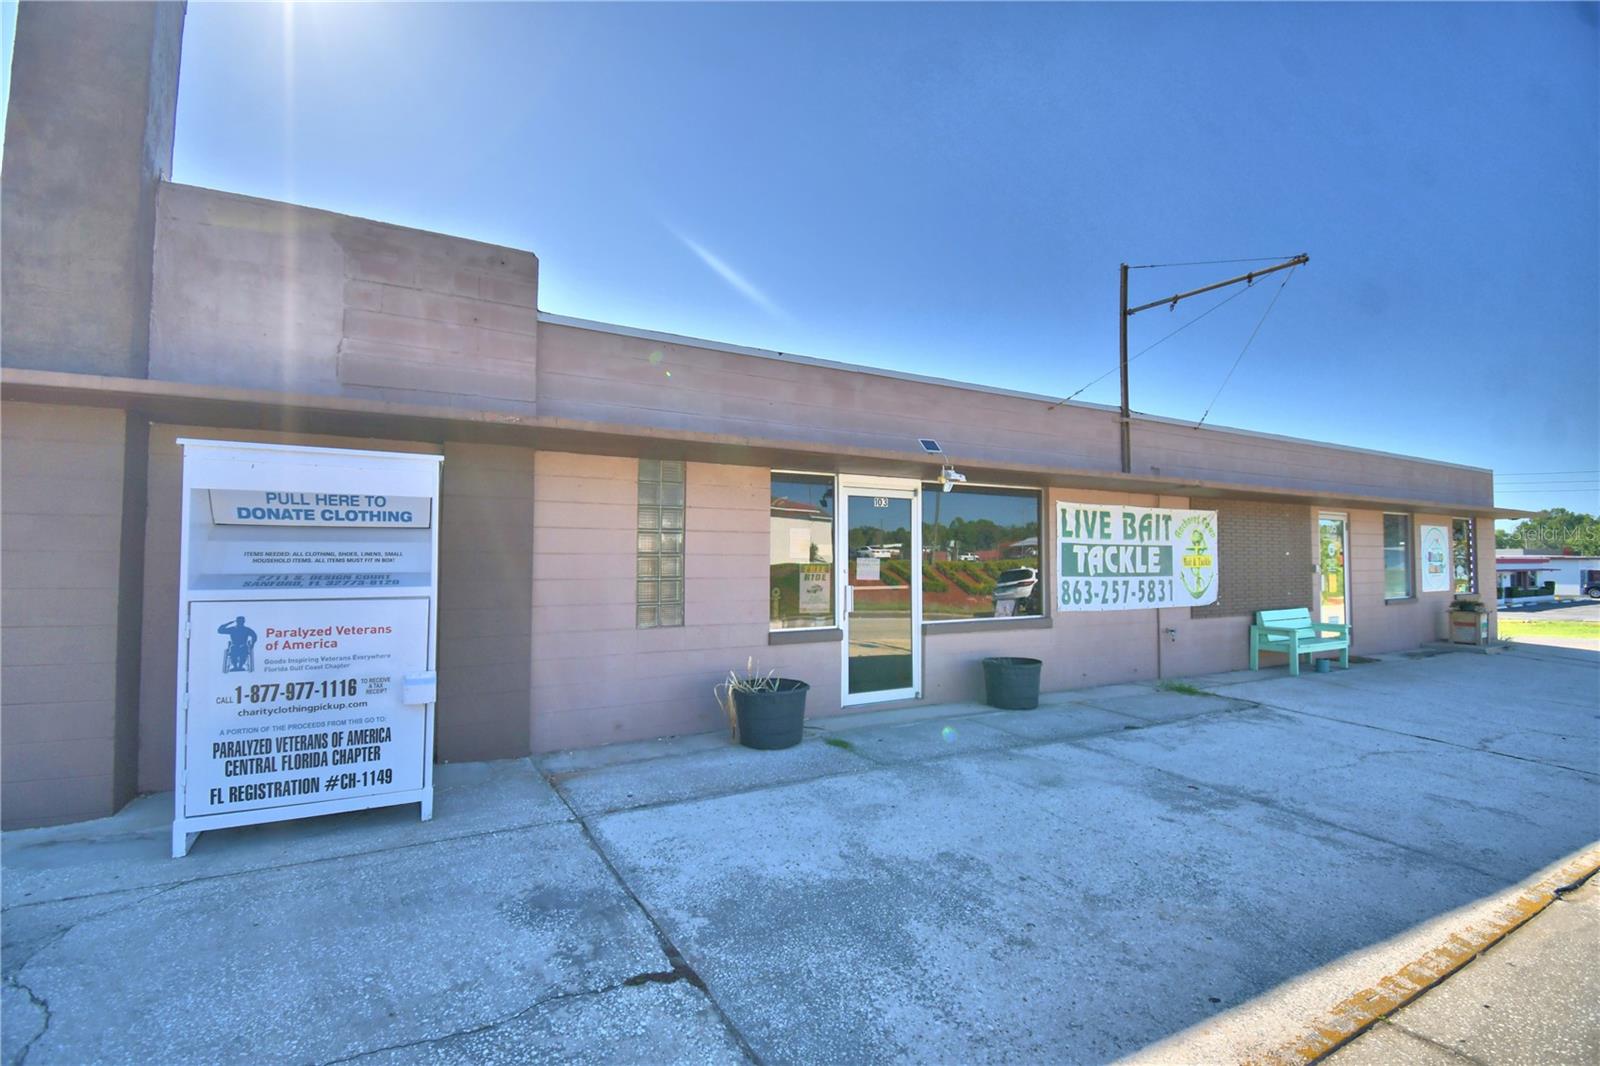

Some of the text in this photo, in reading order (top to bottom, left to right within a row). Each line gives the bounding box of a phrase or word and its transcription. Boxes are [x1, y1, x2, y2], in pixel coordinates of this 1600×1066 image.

[266, 492, 387, 508] PULL HERE TO
[874, 497, 888, 508] 103
[237, 506, 413, 523] DONATE CLOTHING
[1061, 508, 1172, 544] LIVE BAIT
[1073, 545, 1160, 576] TACKLE
[1061, 579, 1173, 605] 863-257-5831
[265, 625, 392, 639] Paralyzed Veterans
[265, 639, 338, 651] of America
[288, 656, 319, 665] Inspiring
[352, 653, 391, 661] Everywhere
[235, 678, 357, 704] 1-877-977-1116
[238, 700, 368, 717] charityclothingpickup.com
[226, 727, 259, 735] PORTION
[272, 724, 286, 732] THE
[288, 721, 326, 730] PROCEEDS
[327, 719, 347, 727] FROM
[212, 727, 392, 759] PARALYZED VETERANS OF AMERICA
[224, 745, 381, 777] CENTRAL FLORIDA CHAPTER
[210, 768, 393, 805] FL REGISTRATION #CH-1149
